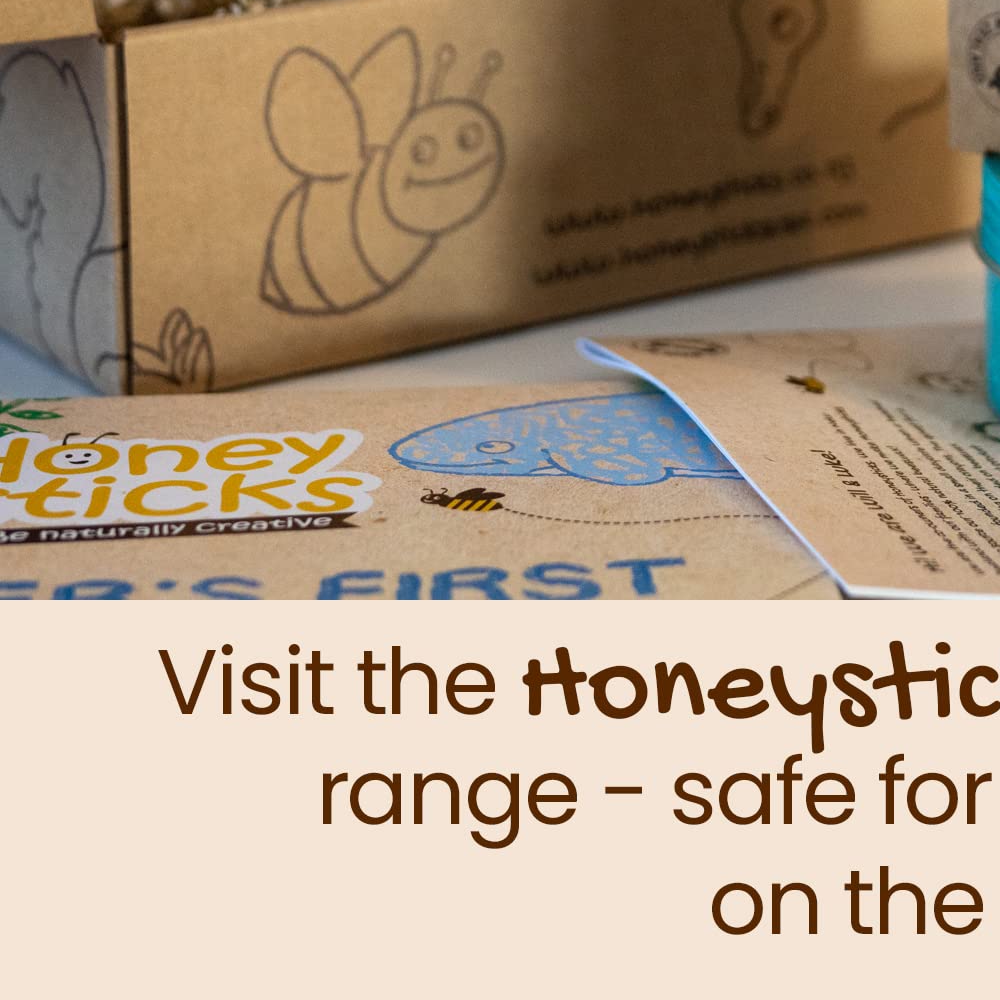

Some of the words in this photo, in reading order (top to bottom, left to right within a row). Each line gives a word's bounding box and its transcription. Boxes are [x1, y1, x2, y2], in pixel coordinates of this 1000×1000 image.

[810, 449, 854, 477] Luke!
[0, 473, 363, 518] ticks
[40, 522, 186, 541] naturally
[316, 556, 686, 600] FIRST
